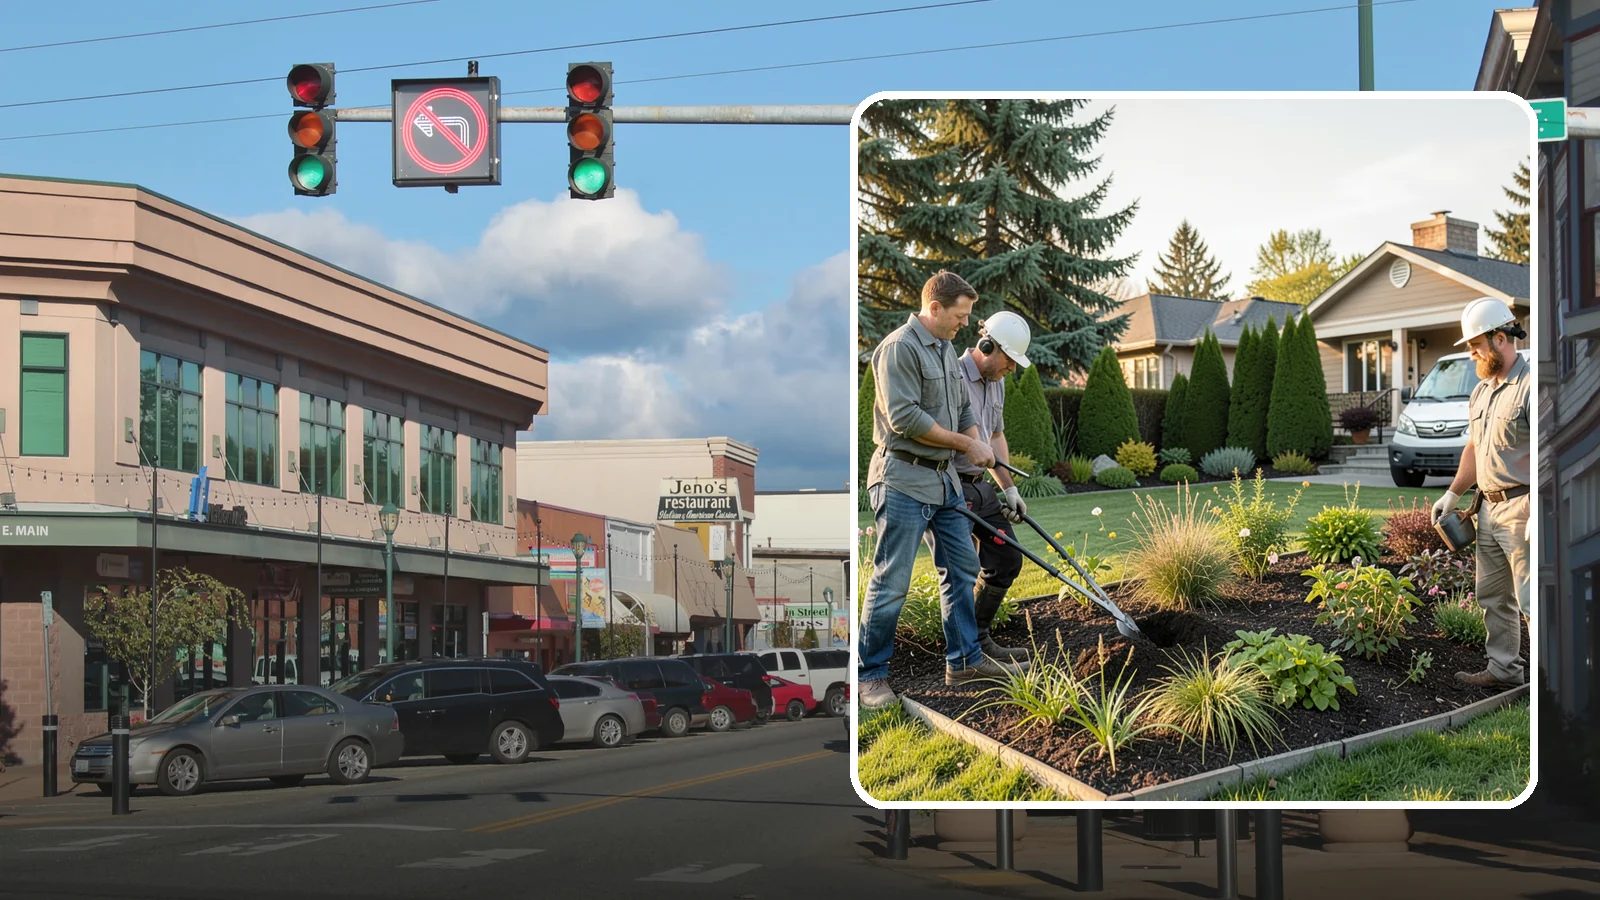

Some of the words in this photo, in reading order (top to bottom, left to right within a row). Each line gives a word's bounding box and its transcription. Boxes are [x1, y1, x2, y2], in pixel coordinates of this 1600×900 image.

[669, 480, 727, 495] Jeno's
[665, 496, 731, 509] restaurant
[659, 510, 681, 519] Italian
[686, 510, 714, 519] American
[715, 509, 738, 519] Cuisine
[2, 525, 13, 536] E.
[15, 525, 49, 536] MAIN
[797, 607, 828, 617] Street
[790, 619, 824, 627] lass
